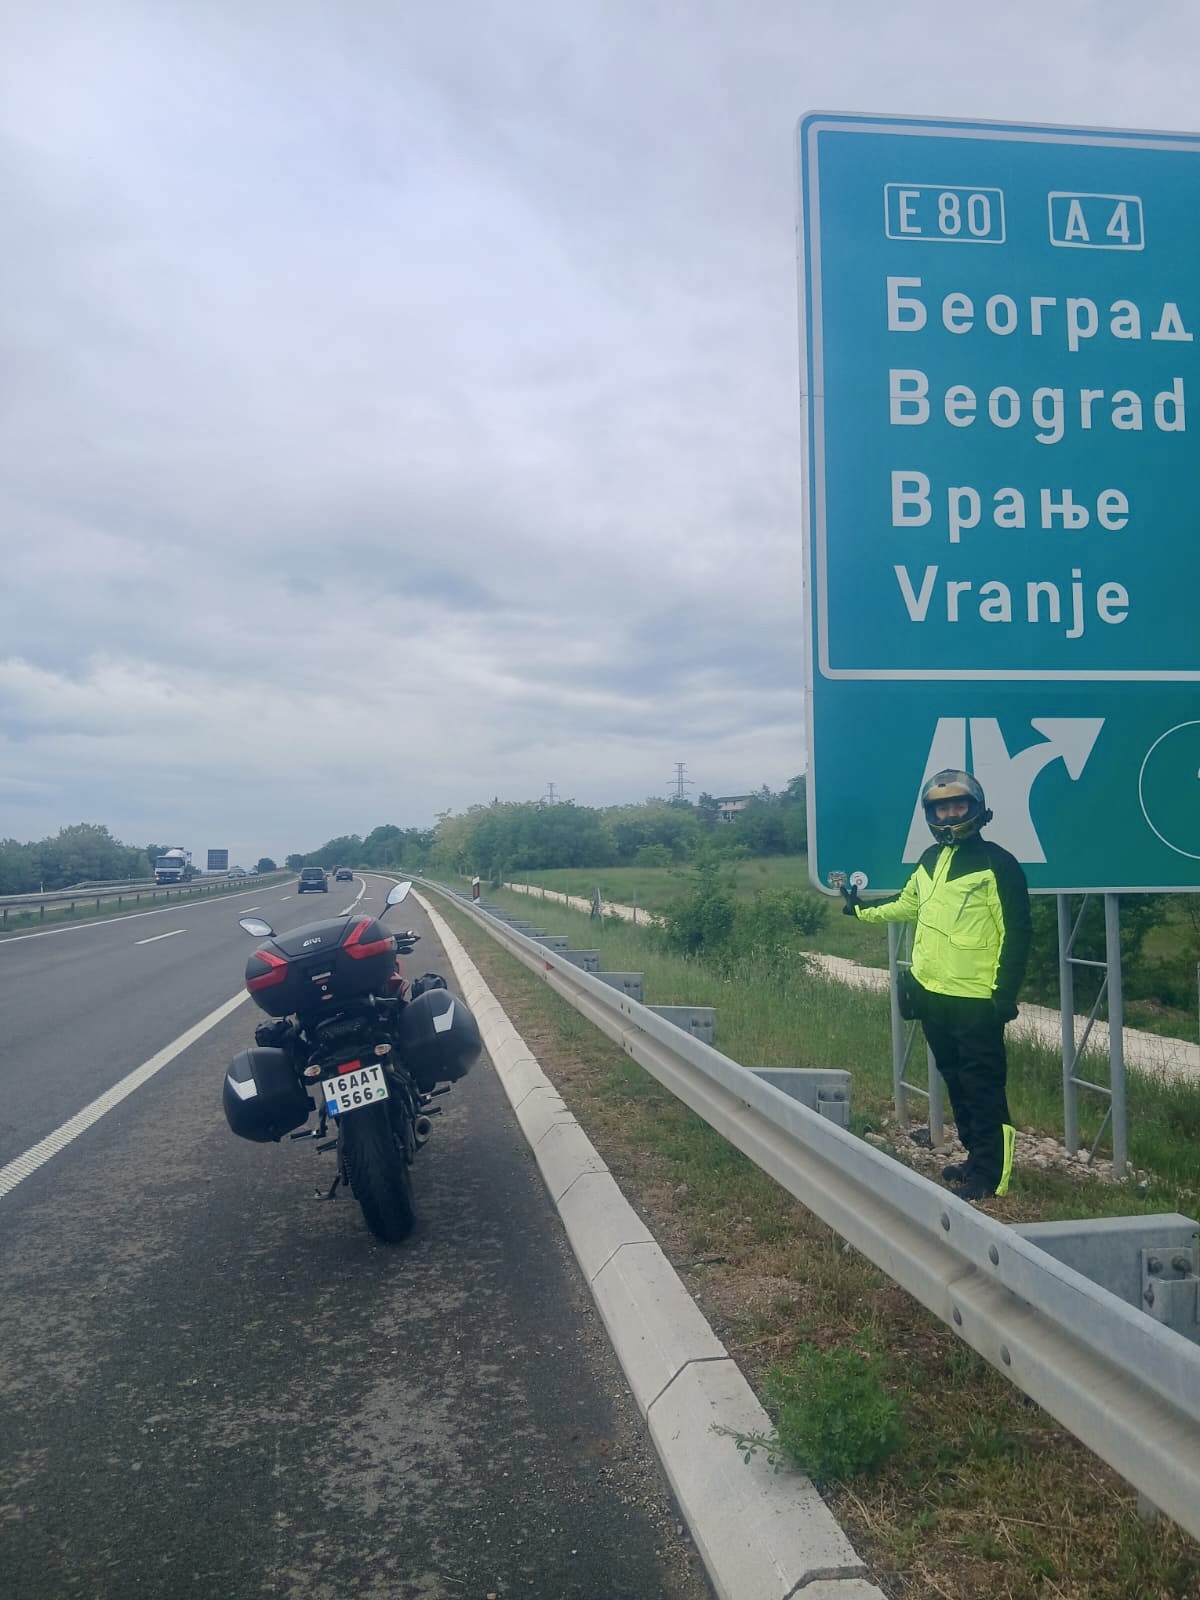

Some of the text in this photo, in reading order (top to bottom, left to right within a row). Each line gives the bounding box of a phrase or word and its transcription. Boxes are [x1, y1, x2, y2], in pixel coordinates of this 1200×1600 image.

[899, 190, 991, 237] E 80
[1064, 199, 1131, 244] A 4
[886, 276, 1194, 352] Београд
[888, 368, 1186, 445] Beograd
[890, 470, 1130, 543] Врање
[894, 565, 1130, 639] Vranje
[328, 1067, 379, 1095] 16AAT
[341, 1087, 373, 1108] 566
